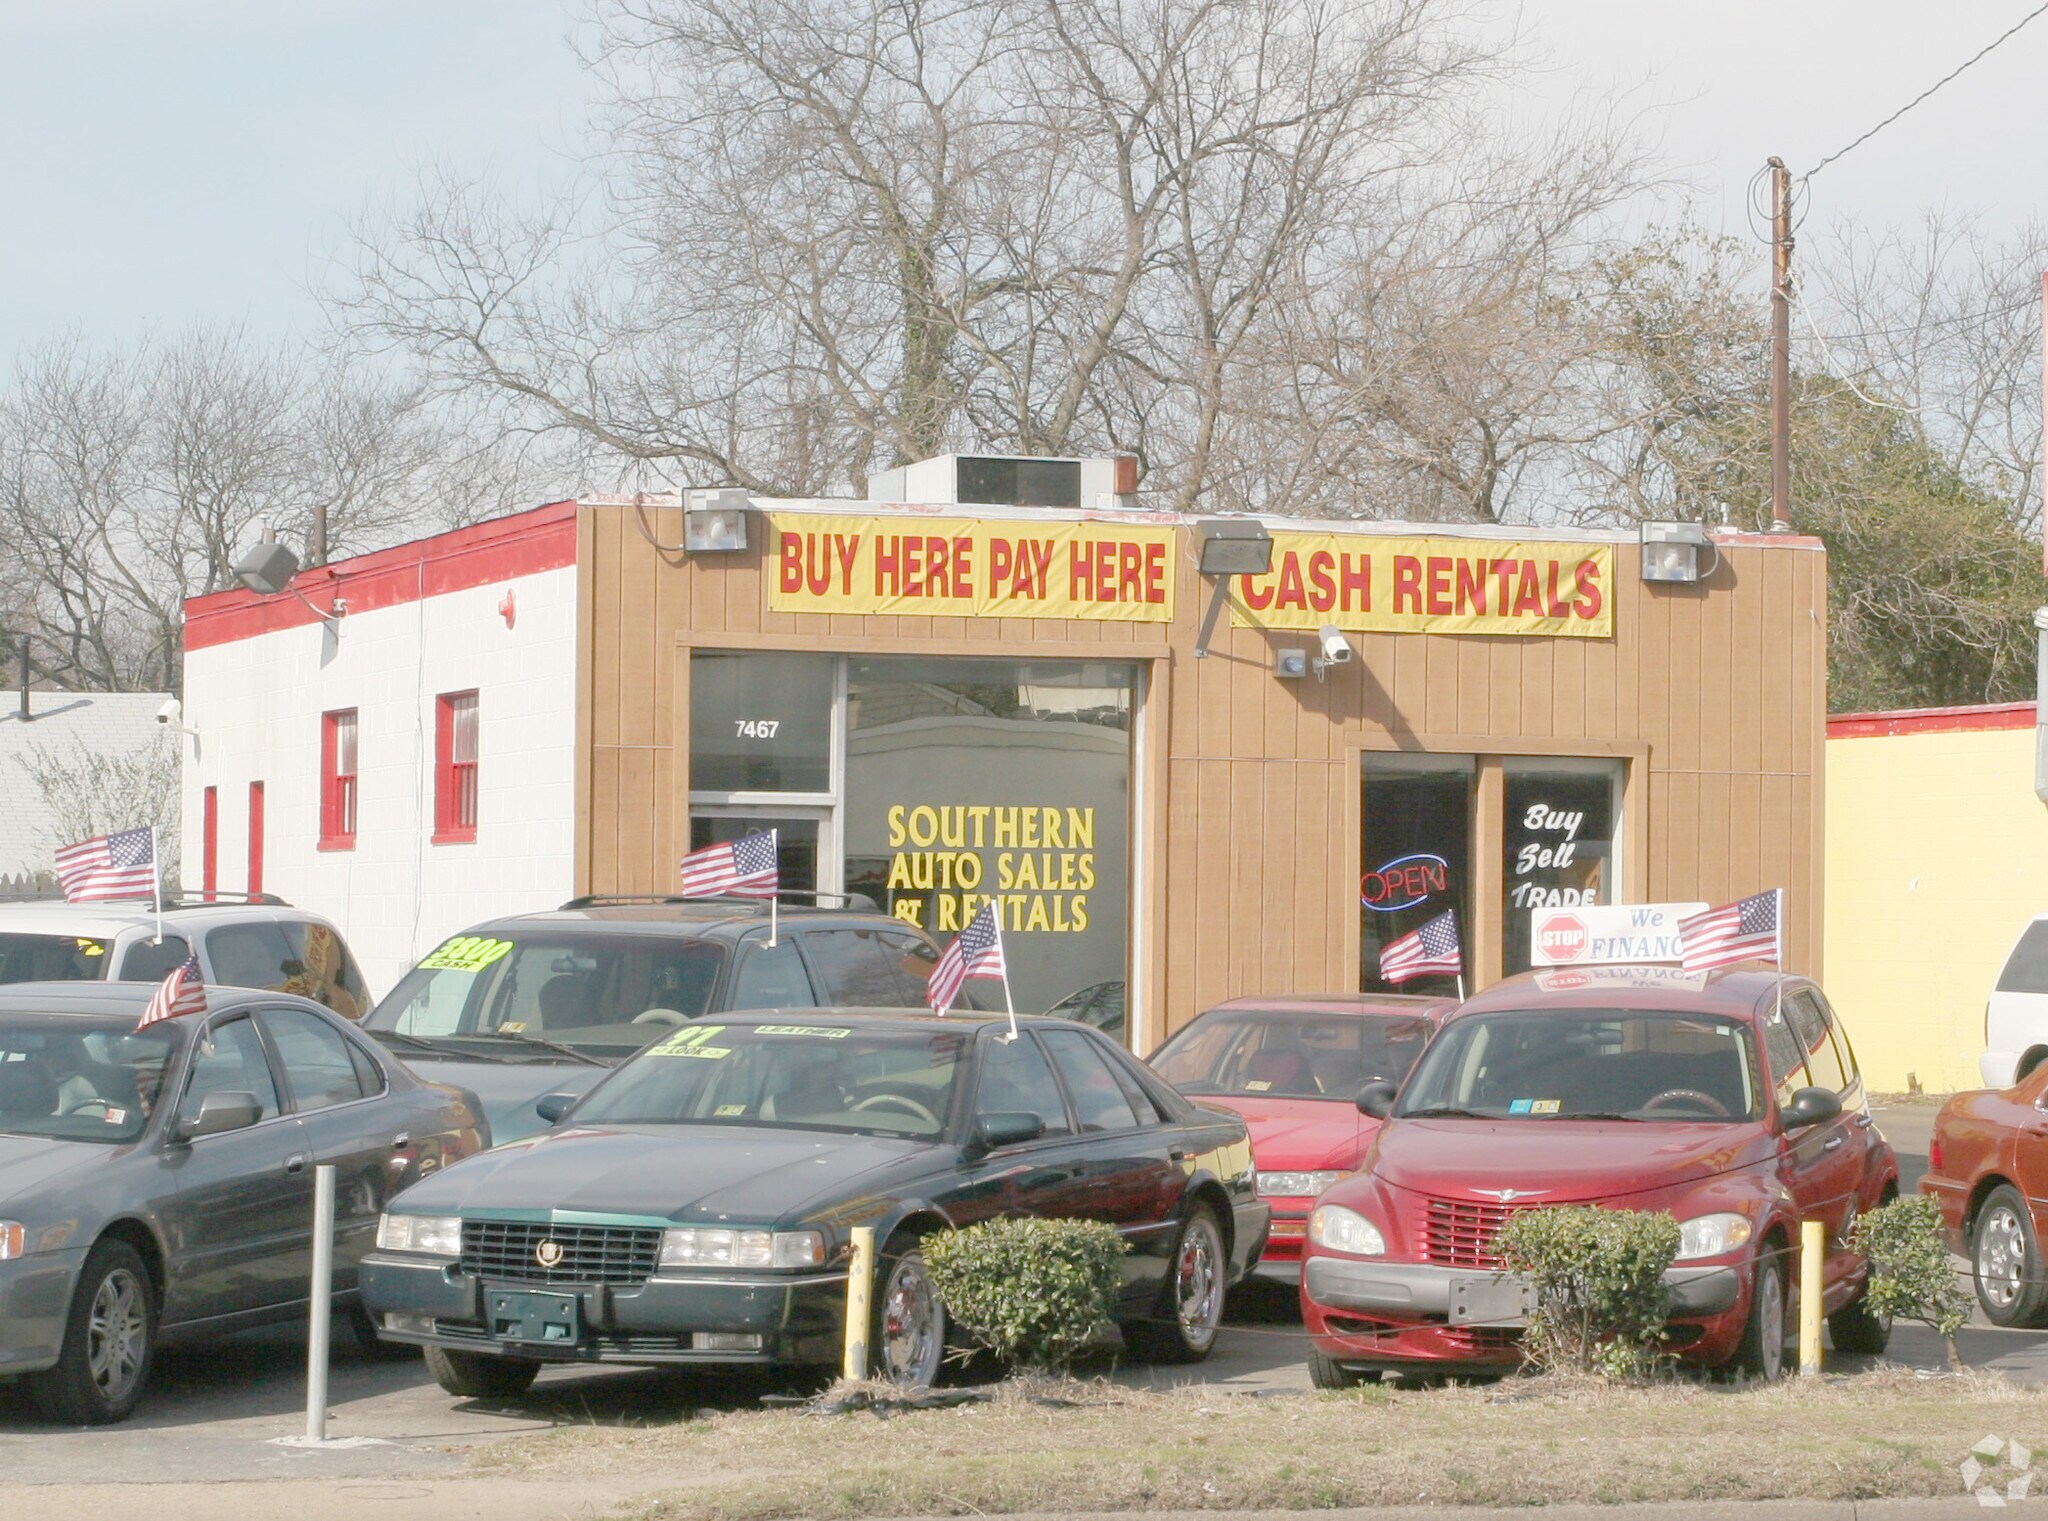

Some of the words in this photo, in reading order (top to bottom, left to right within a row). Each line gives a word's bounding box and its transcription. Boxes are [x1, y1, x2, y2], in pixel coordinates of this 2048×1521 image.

[780, 531, 860, 597] BUY
[874, 535, 974, 599] HERE
[988, 537, 1055, 601] PAY
[1069, 540, 1166, 604] HERE
[1240, 550, 1372, 613] CASH
[1392, 554, 1602, 620] RENTALS
[735, 720, 780, 739] 7467
[887, 804, 1096, 849] SOUTHERN
[1523, 803, 1584, 841] Buy
[886, 851, 983, 891] AUTO
[997, 851, 1096, 892] SALES
[1515, 842, 1576, 875] Sell
[1361, 863, 1447, 903] OPEN
[1511, 881, 1597, 908] TRADE
[1630, 908, 1664, 927] We
[1543, 929, 1584, 947] STOP
[1590, 935, 1687, 960] FINANC
